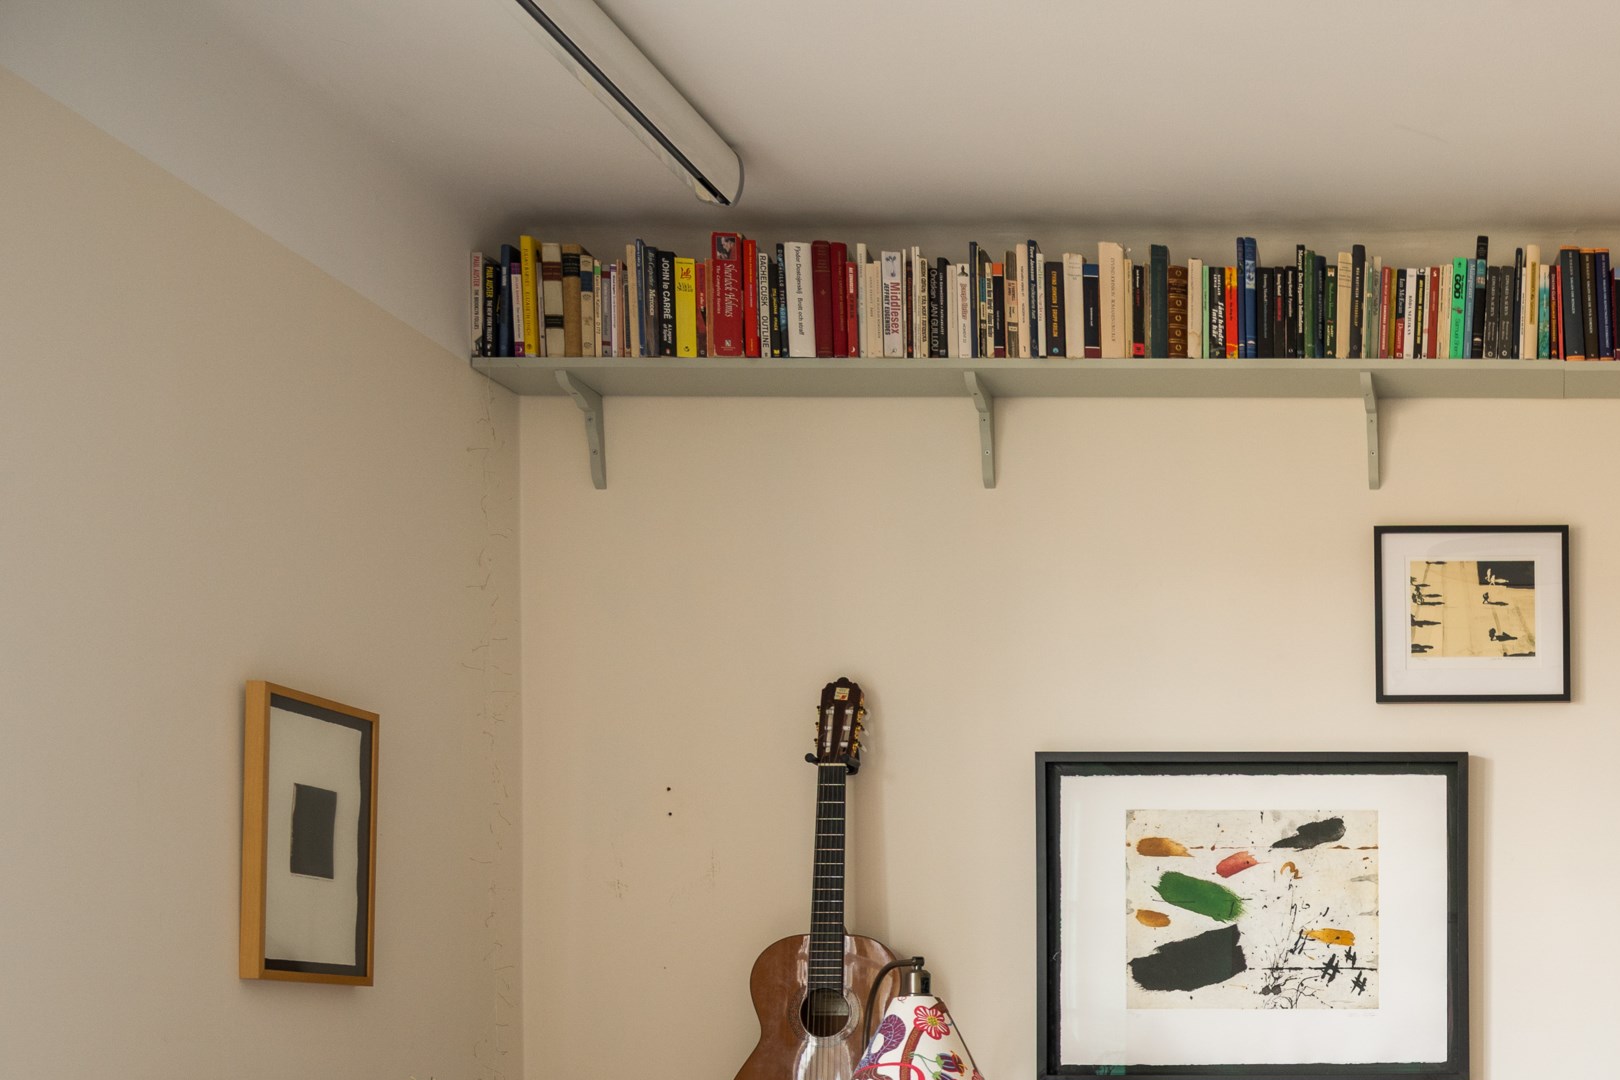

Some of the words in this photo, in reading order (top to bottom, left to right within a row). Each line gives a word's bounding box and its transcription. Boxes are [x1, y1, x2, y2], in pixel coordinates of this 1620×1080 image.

[661, 258, 669, 281] JOHN
[723, 264, 737, 291] Sherlock
[760, 256, 768, 285] RACHEL
[663, 291, 672, 320] CARRÉ
[724, 293, 738, 318] Holmes
[761, 286, 769, 307] CUSK
[890, 282, 900, 334] Middlesex
